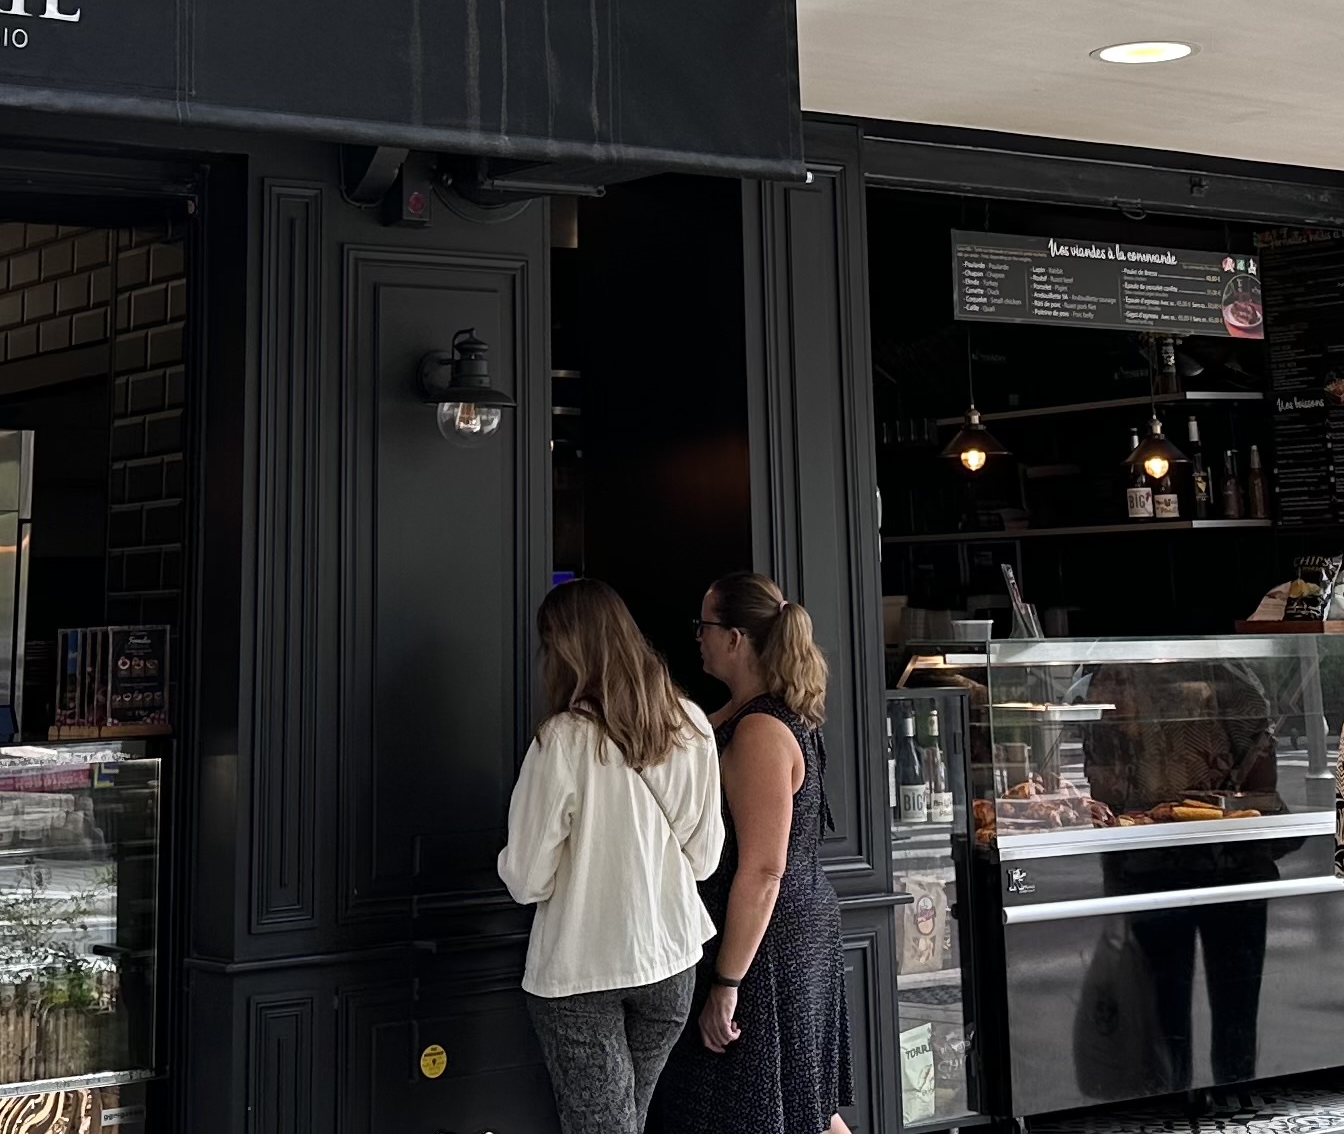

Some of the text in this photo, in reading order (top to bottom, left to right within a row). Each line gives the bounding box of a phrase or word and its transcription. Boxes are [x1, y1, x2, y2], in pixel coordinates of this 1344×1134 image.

[1070, 244, 1106, 260] viandes
[1115, 243, 1127, 261] la
[1127, 251, 1178, 265] commande
